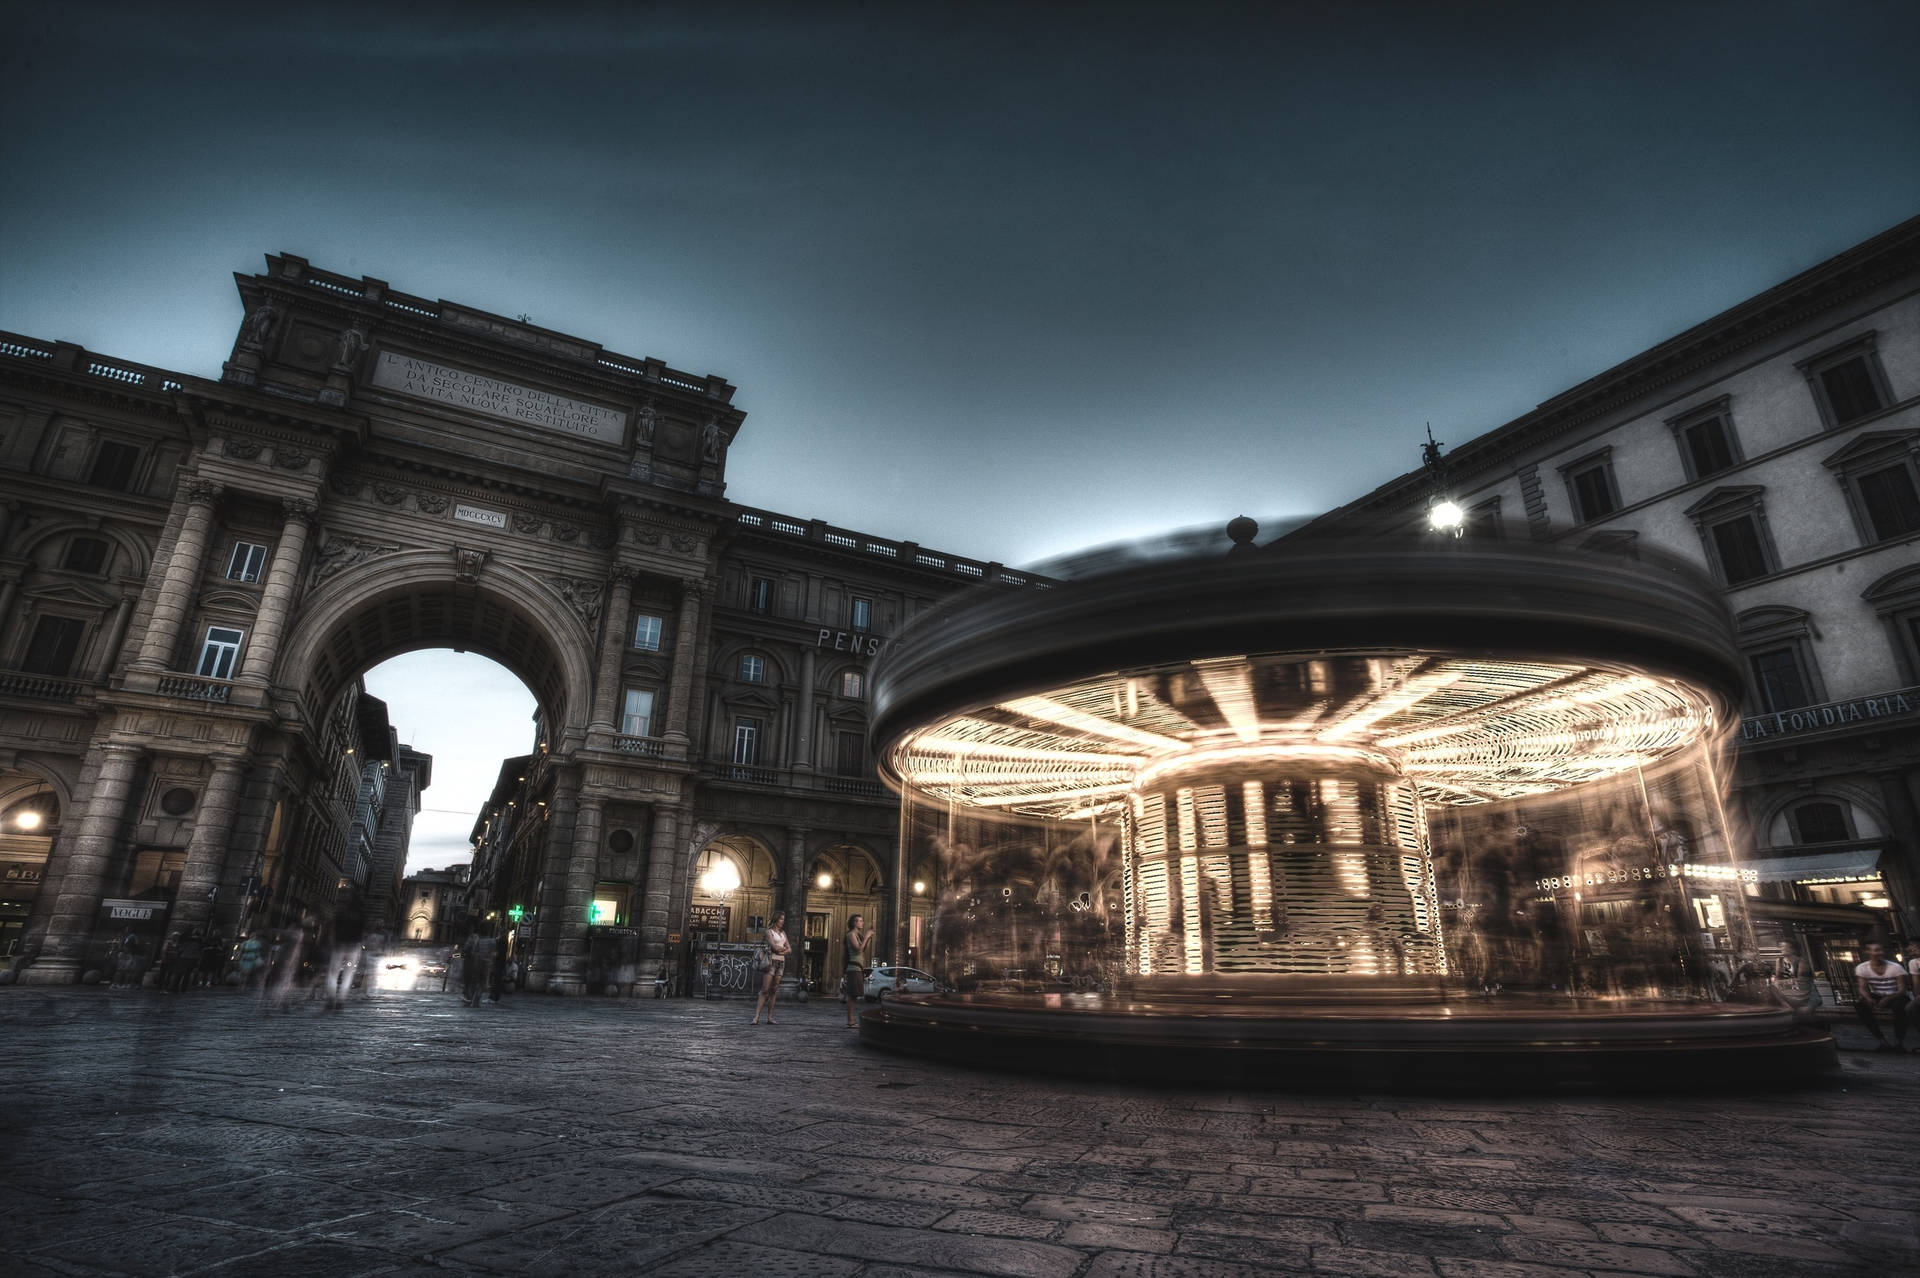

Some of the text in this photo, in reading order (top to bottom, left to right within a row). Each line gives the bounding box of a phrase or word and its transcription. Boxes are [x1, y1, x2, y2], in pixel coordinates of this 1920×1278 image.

[404, 359, 459, 379] ANTICO
[464, 375, 522, 396] CENTRO
[527, 391, 573, 409] DELLA
[406, 370, 599, 426] DA SECOLARE SQUALLORE
[404, 381, 598, 435] A VITA NUOVA RESTITUITO
[457, 508, 503, 523] MDCCCXCV
[1741, 694, 1912, 740] LA FONDIARIA
[112, 908, 152, 919] VOGUE
[690, 907, 725, 915] ABACCHI
